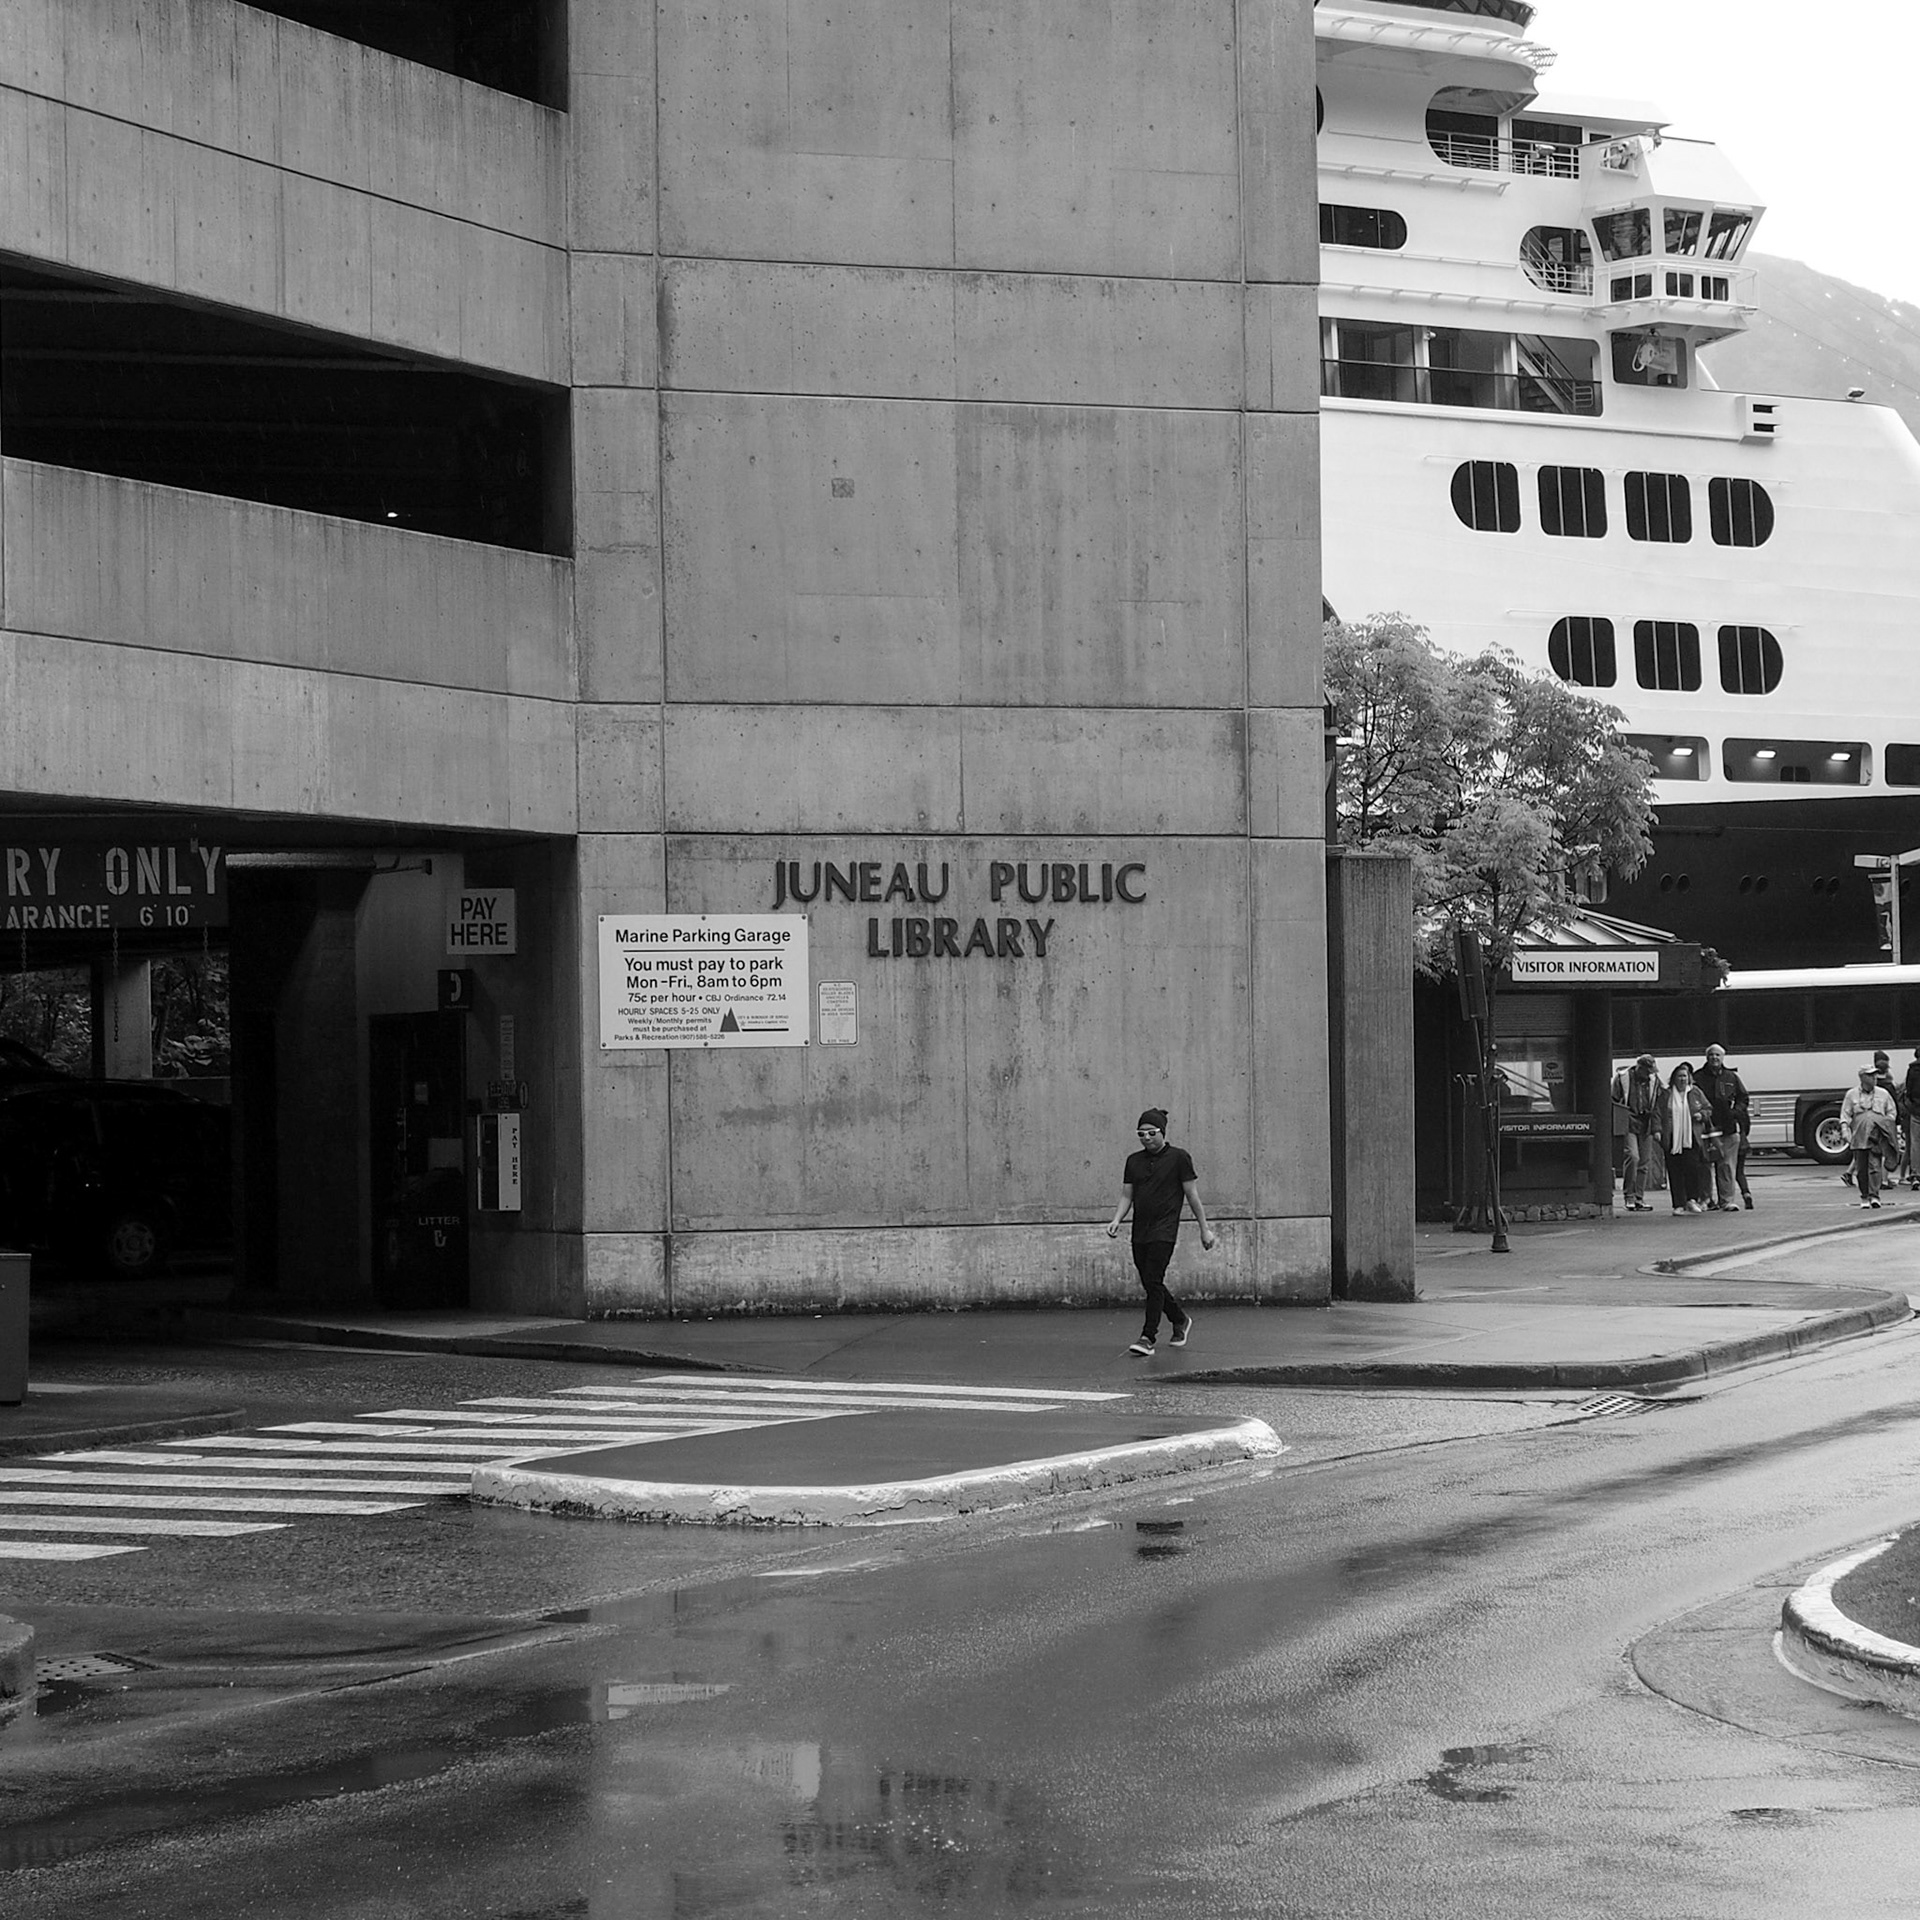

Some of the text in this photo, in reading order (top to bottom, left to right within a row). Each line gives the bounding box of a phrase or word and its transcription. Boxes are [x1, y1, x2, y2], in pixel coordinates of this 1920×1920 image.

[105, 846, 221, 896] ONLY
[771, 860, 1147, 909] JUNEAU PUBLIC
[461, 897, 497, 920] PAY
[0, 905, 110, 929] ARANCE
[451, 923, 508, 946] HERE
[615, 928, 791, 945] Marine Parking Garage
[868, 917, 1055, 958] LIBRARY
[624, 956, 784, 973] You must pay to park
[1516, 961, 1656, 973] VISITOR INFORMATION
[626, 975, 658, 989] Mon
[697, 975, 729, 988] 8am
[732, 975, 747, 988] to
[749, 974, 783, 990] 6pm
[650, 994, 669, 1005] per
[672, 991, 697, 1003] hour
[705, 993, 722, 1003] CBJ
[724, 992, 764, 1002] Ordinance
[618, 1006, 721, 1016] HOURLY SPACES 5-25 ONLY
[685, 1017, 713, 1025] permits
[641, 1033, 679, 1041] Recreation
[652, 1025, 661, 1033] be
[662, 1025, 699, 1034] purchased
[1499, 1123, 1590, 1132] VISITOR INFORMATION
[511, 1127, 519, 1185] PAY HERE
[418, 1216, 460, 1226] LITTER
